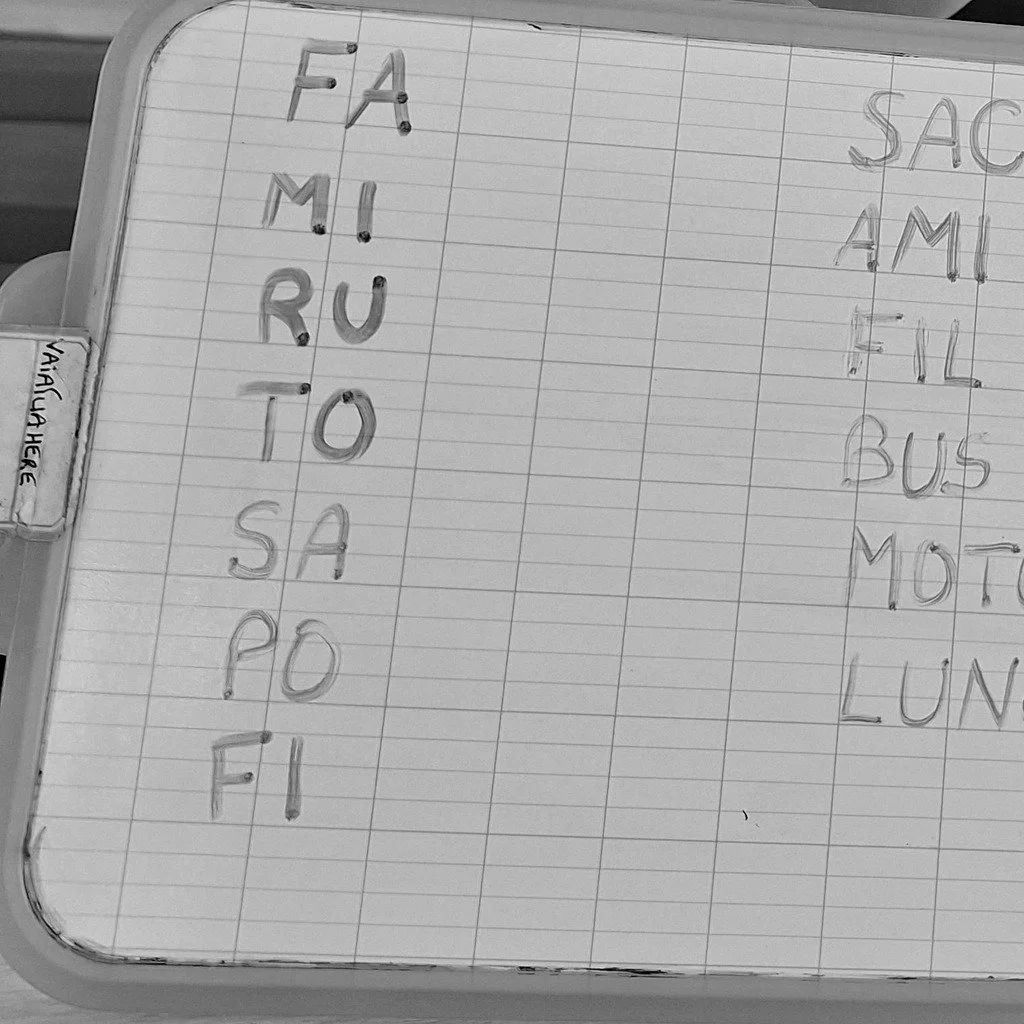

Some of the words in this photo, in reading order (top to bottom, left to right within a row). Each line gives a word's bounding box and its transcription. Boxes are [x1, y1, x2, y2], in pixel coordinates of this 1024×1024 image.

[287, 37, 411, 136] FA
[262, 172, 377, 244] MI
[833, 203, 991, 284] AMI
[258, 267, 387, 346] RU
[846, 304, 982, 388] FIL
[237, 380, 377, 463] TO
[840, 414, 990, 499] BUS
[228, 500, 350, 580] SA
[223, 609, 342, 703] PO
[211, 730, 303, 821] FI
